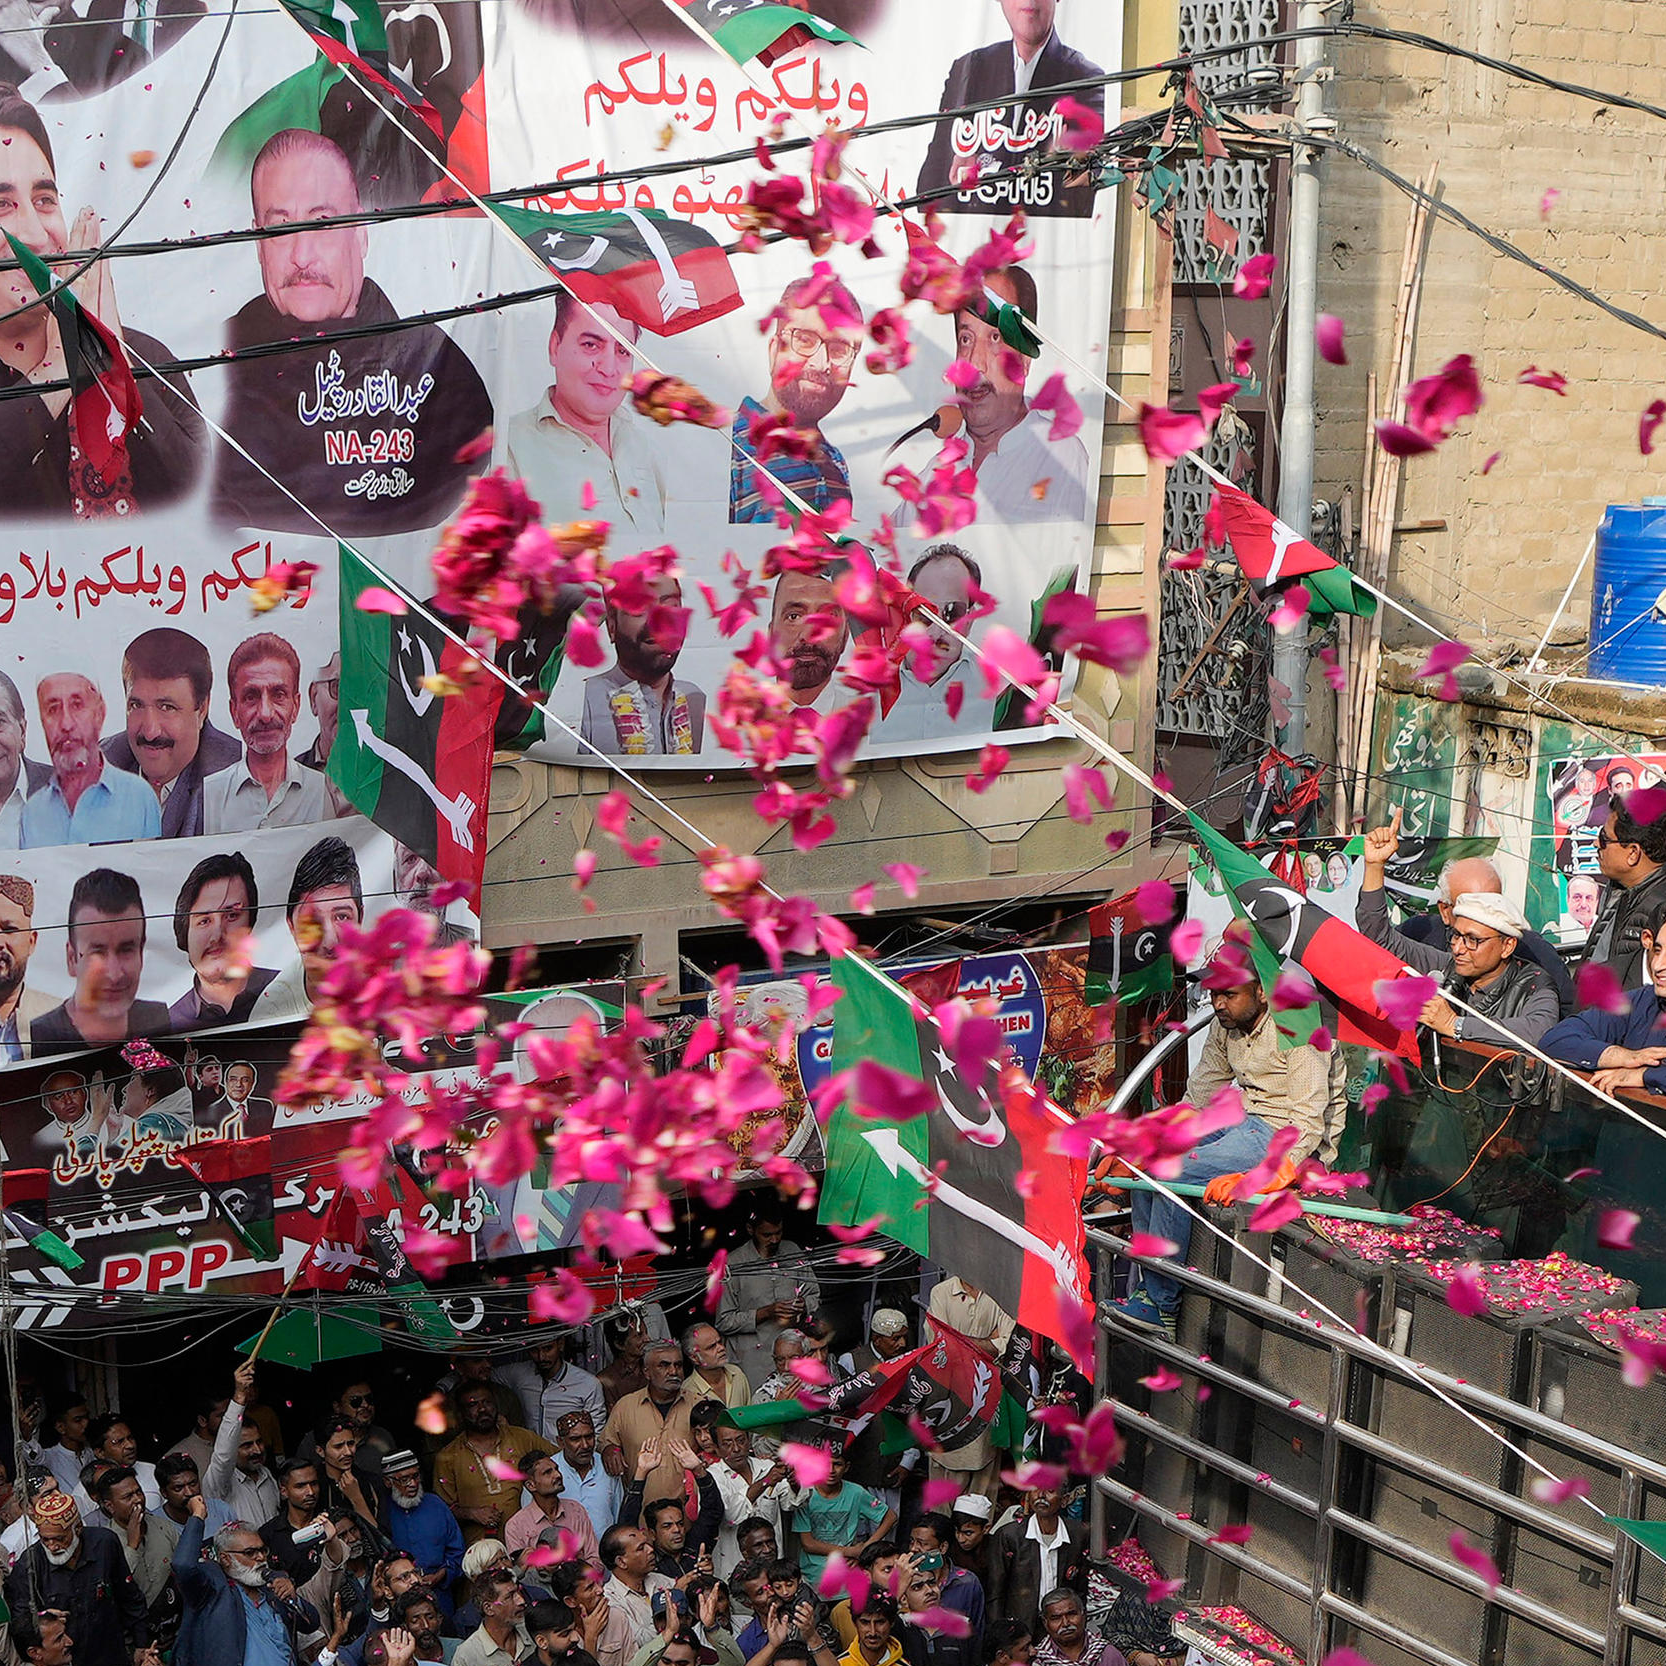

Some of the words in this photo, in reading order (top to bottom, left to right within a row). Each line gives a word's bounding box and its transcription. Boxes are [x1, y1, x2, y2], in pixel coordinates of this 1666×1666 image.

[583, 50, 718, 133] ویلکم
[734, 56, 870, 132] ویلکم
[325, 429, 415, 465] NA-243
[74, 545, 186, 615] ویلکم
[100, 1239, 233, 1308] PPP
